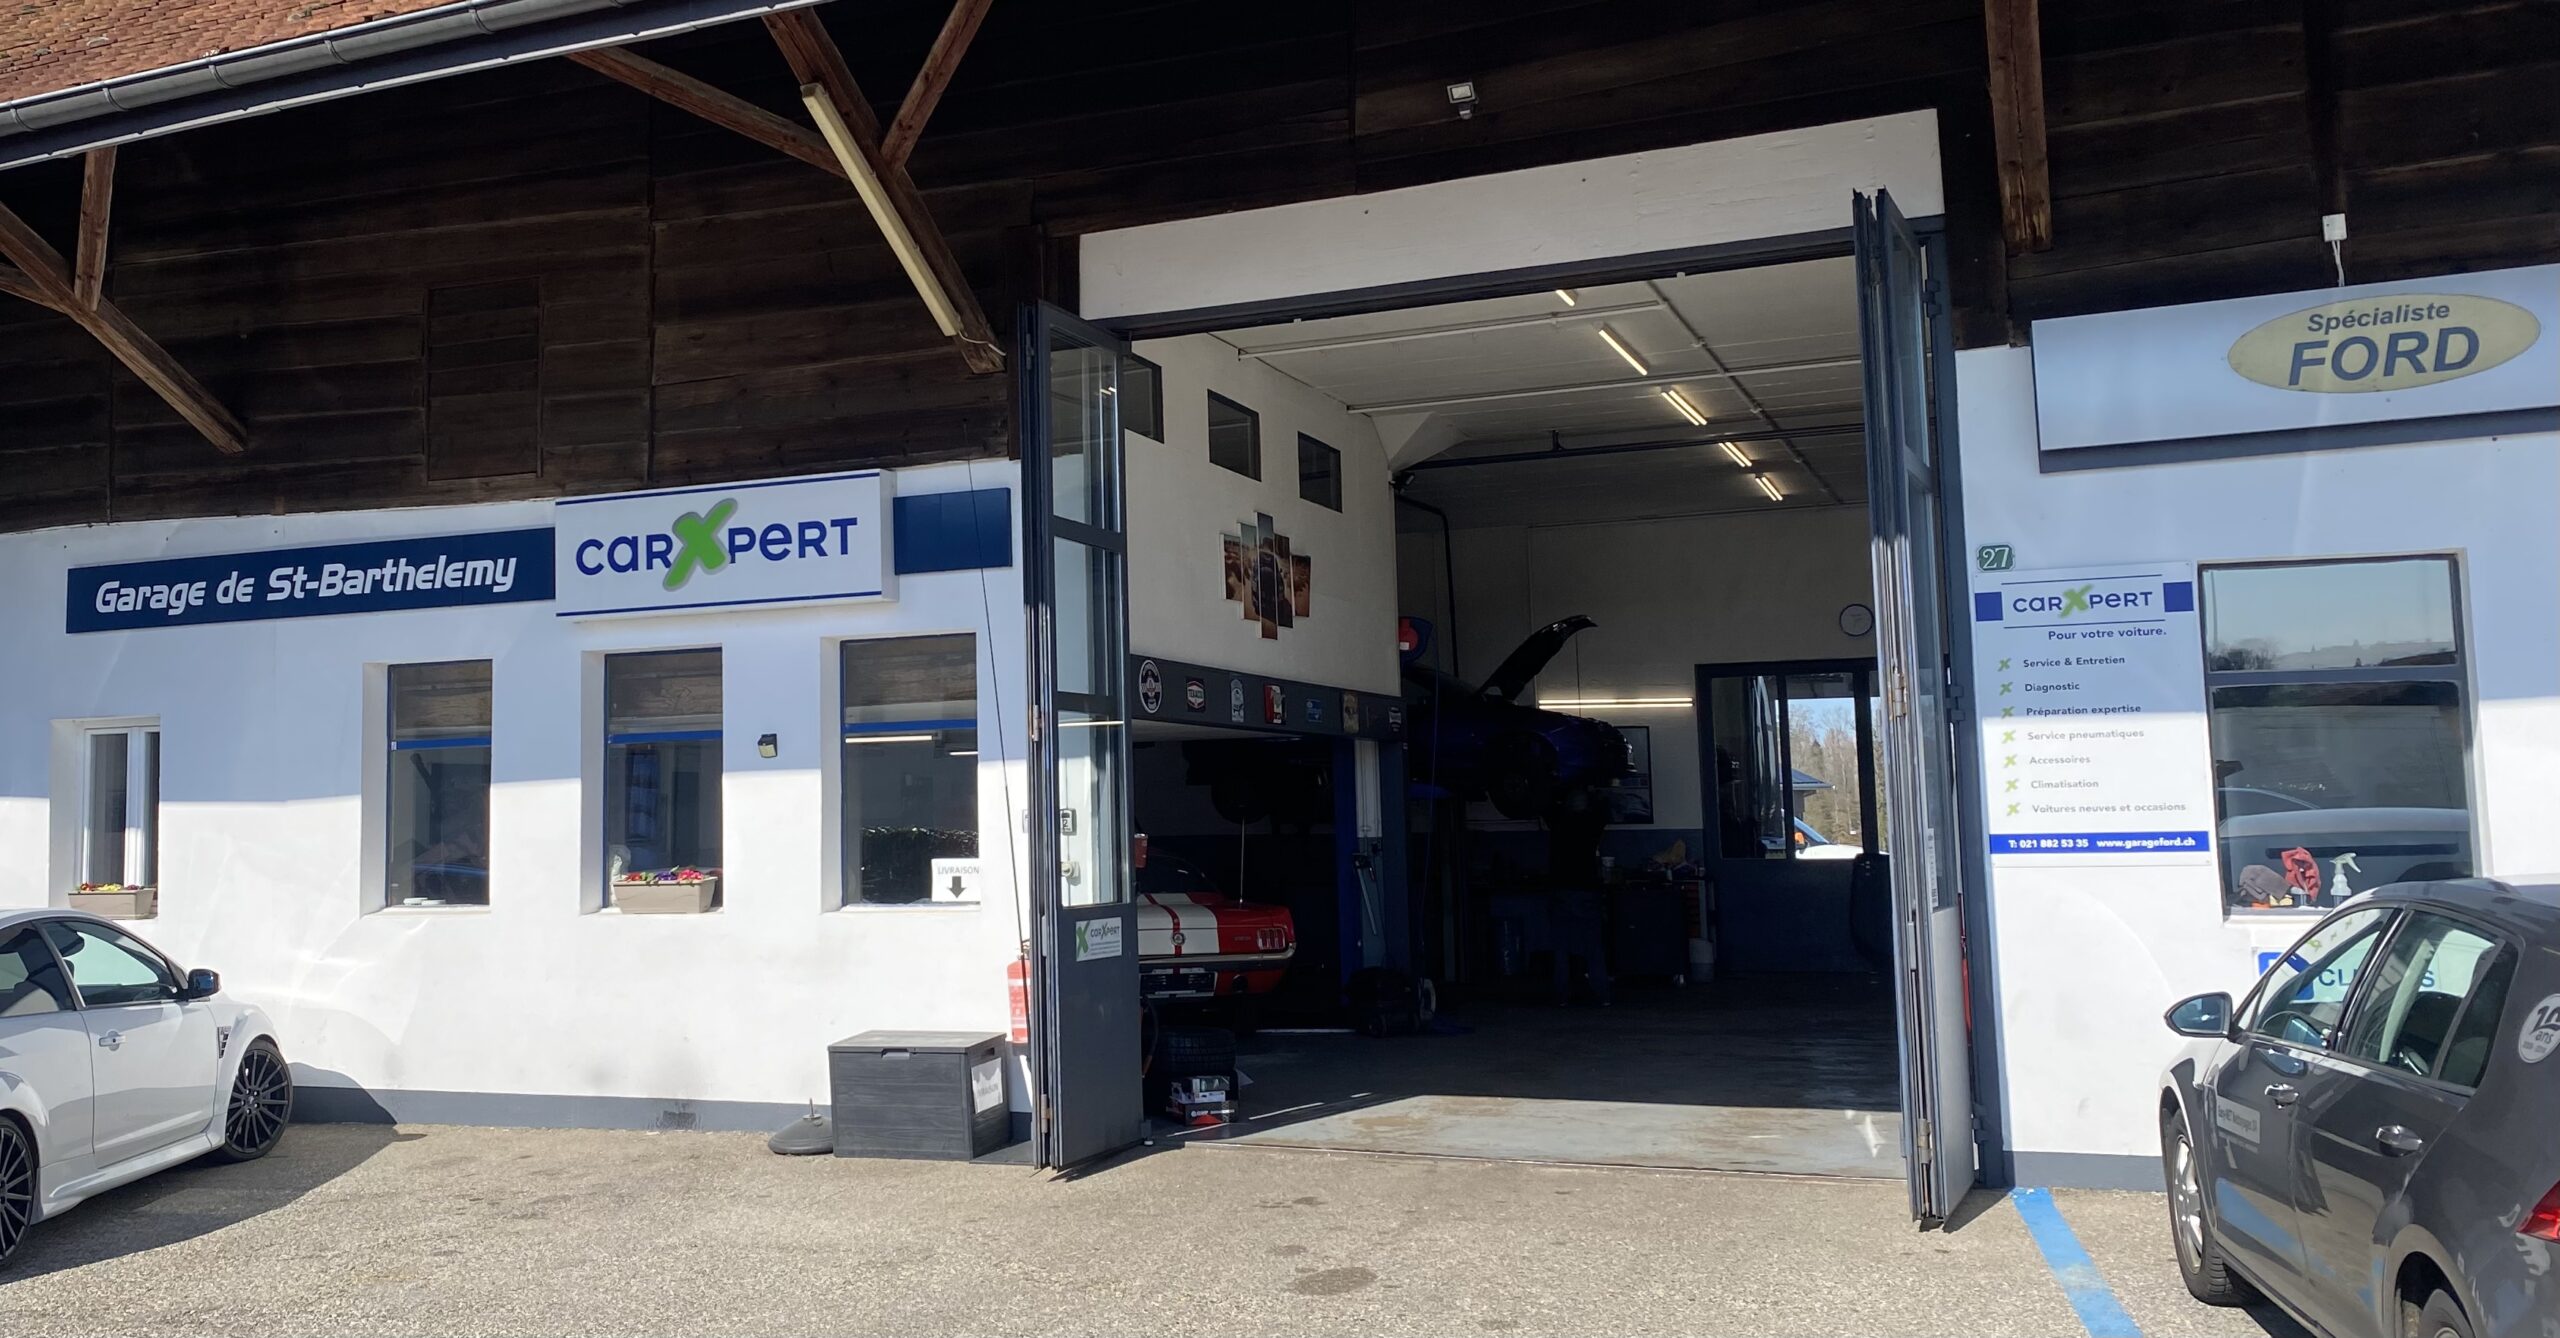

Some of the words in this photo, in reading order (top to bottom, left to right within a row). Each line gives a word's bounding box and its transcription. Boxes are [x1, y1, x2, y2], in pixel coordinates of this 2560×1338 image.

[2307, 302, 2450, 335] Spécialiste
[2288, 326, 2480, 386] FORD
[1982, 547, 2009, 569] 27
[95, 580, 207, 616] Garage
[215, 570, 255, 604] de
[266, 554, 518, 602] St-Barthelemy
[2048, 630, 2077, 640] Pour
[2081, 629, 2114, 639] votre
[2118, 626, 2167, 637] voiture.
[2023, 658, 2061, 668] Service
[2064, 657, 2073, 666] &
[2076, 656, 2126, 666] Entretien
[2024, 681, 2080, 693] Diagnostic
[2026, 706, 2088, 717] Préparation
[2091, 704, 2142, 715] expertise
[2027, 730, 2066, 741] Service
[2069, 729, 2145, 741] pneumatiques
[2029, 755, 2091, 765] Accessoires
[2030, 780, 2099, 789] Climatisation
[2032, 803, 2076, 813] Voitures
[2079, 803, 2117, 812] neuves
[2119, 803, 2131, 812] et
[2134, 801, 2187, 812] occasions
[2019, 839, 2038, 848] 021
[937, 865, 980, 875] LIVRAISON
